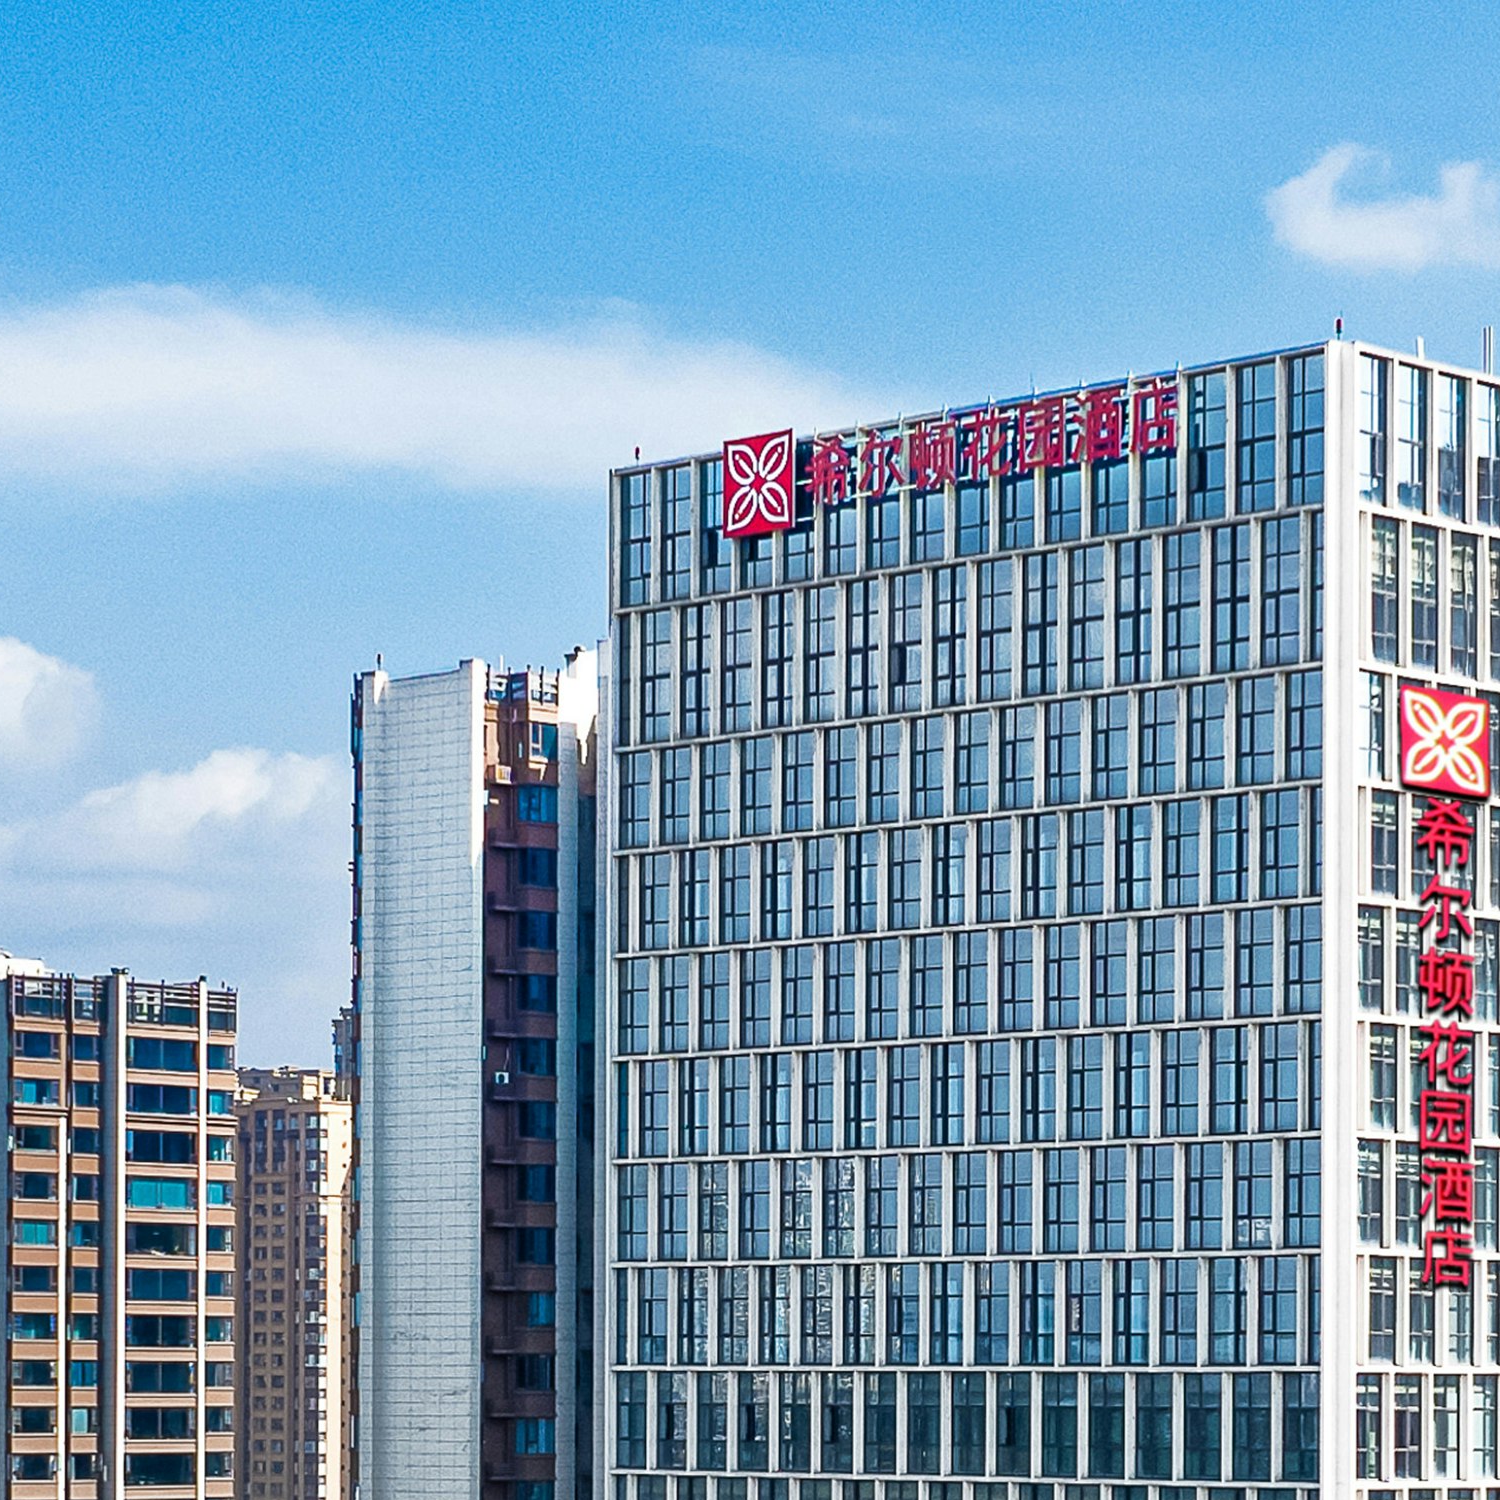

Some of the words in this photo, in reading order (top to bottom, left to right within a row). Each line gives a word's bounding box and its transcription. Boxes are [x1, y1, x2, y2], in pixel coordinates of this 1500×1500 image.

[805, 376, 1178, 505] 希尔顿花园酒店
[1416, 797, 1475, 1287] 希尔顿花园酒店
